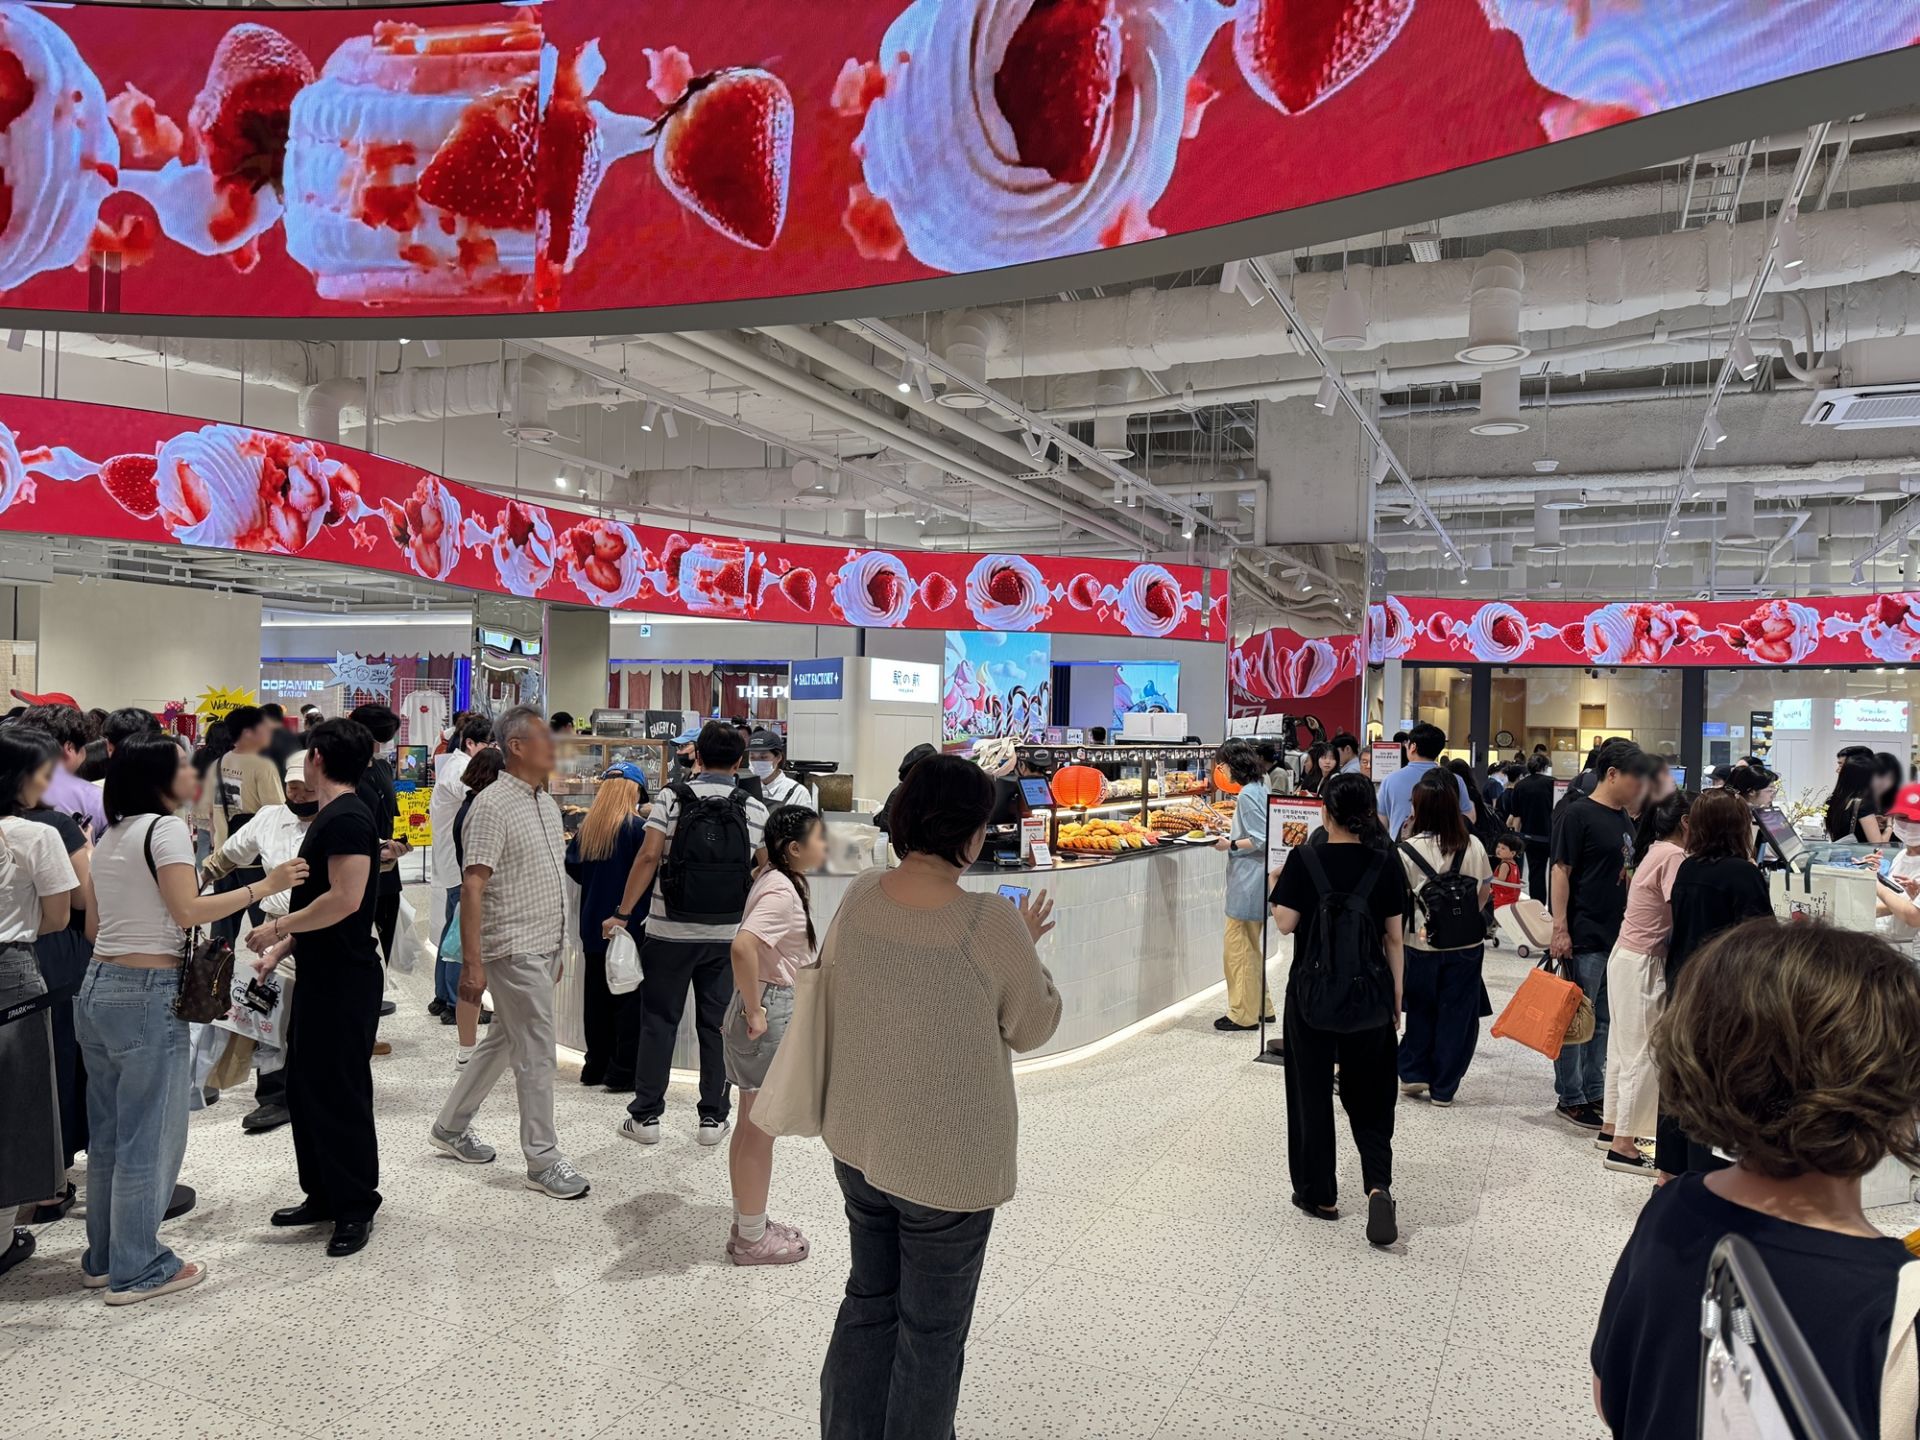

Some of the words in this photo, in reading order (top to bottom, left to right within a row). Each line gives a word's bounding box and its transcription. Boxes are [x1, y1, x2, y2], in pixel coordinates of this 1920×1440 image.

[261, 680, 325, 691] DOPAMINE
[799, 673, 811, 686] SALT
[811, 672, 834, 685] FACTORY
[278, 691, 308, 699] STATION
[736, 685, 769, 698] THE
[649, 721, 670, 738] BAKERY
